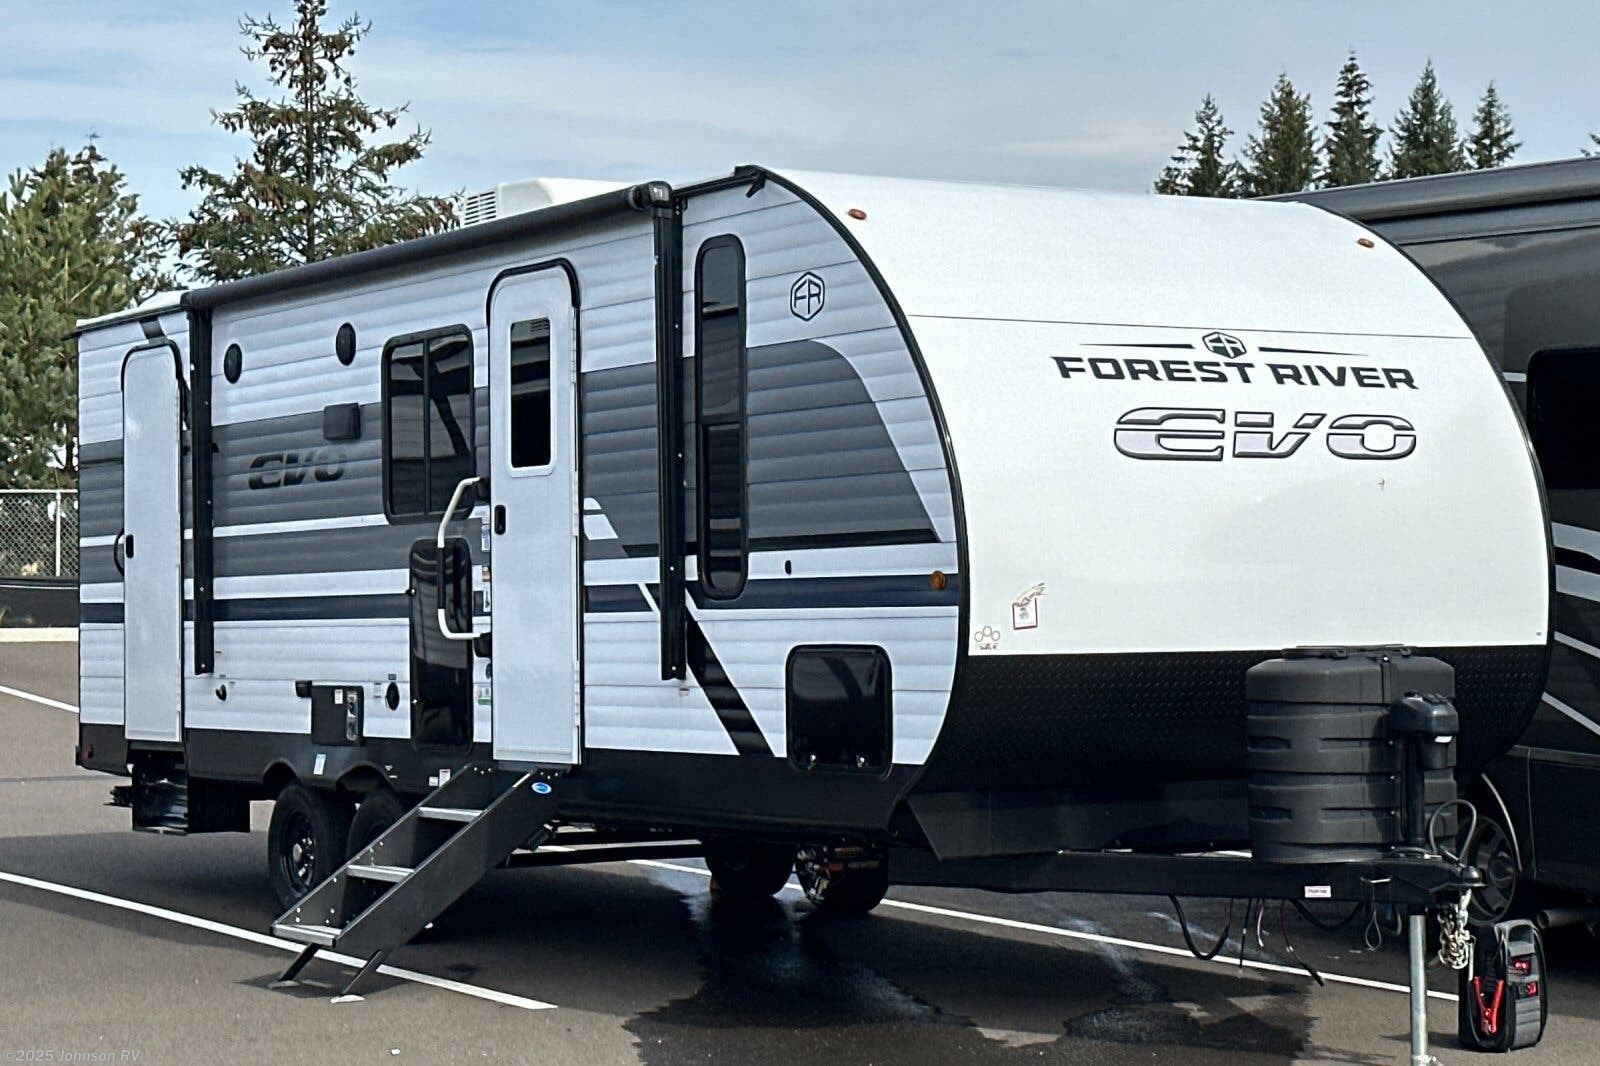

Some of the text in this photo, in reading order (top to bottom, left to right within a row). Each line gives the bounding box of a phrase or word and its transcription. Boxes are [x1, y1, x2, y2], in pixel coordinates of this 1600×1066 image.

[1050, 356, 1420, 390] FOREST RIVER
[1113, 406, 1417, 462] EVO
[248, 450, 347, 490] EVO
